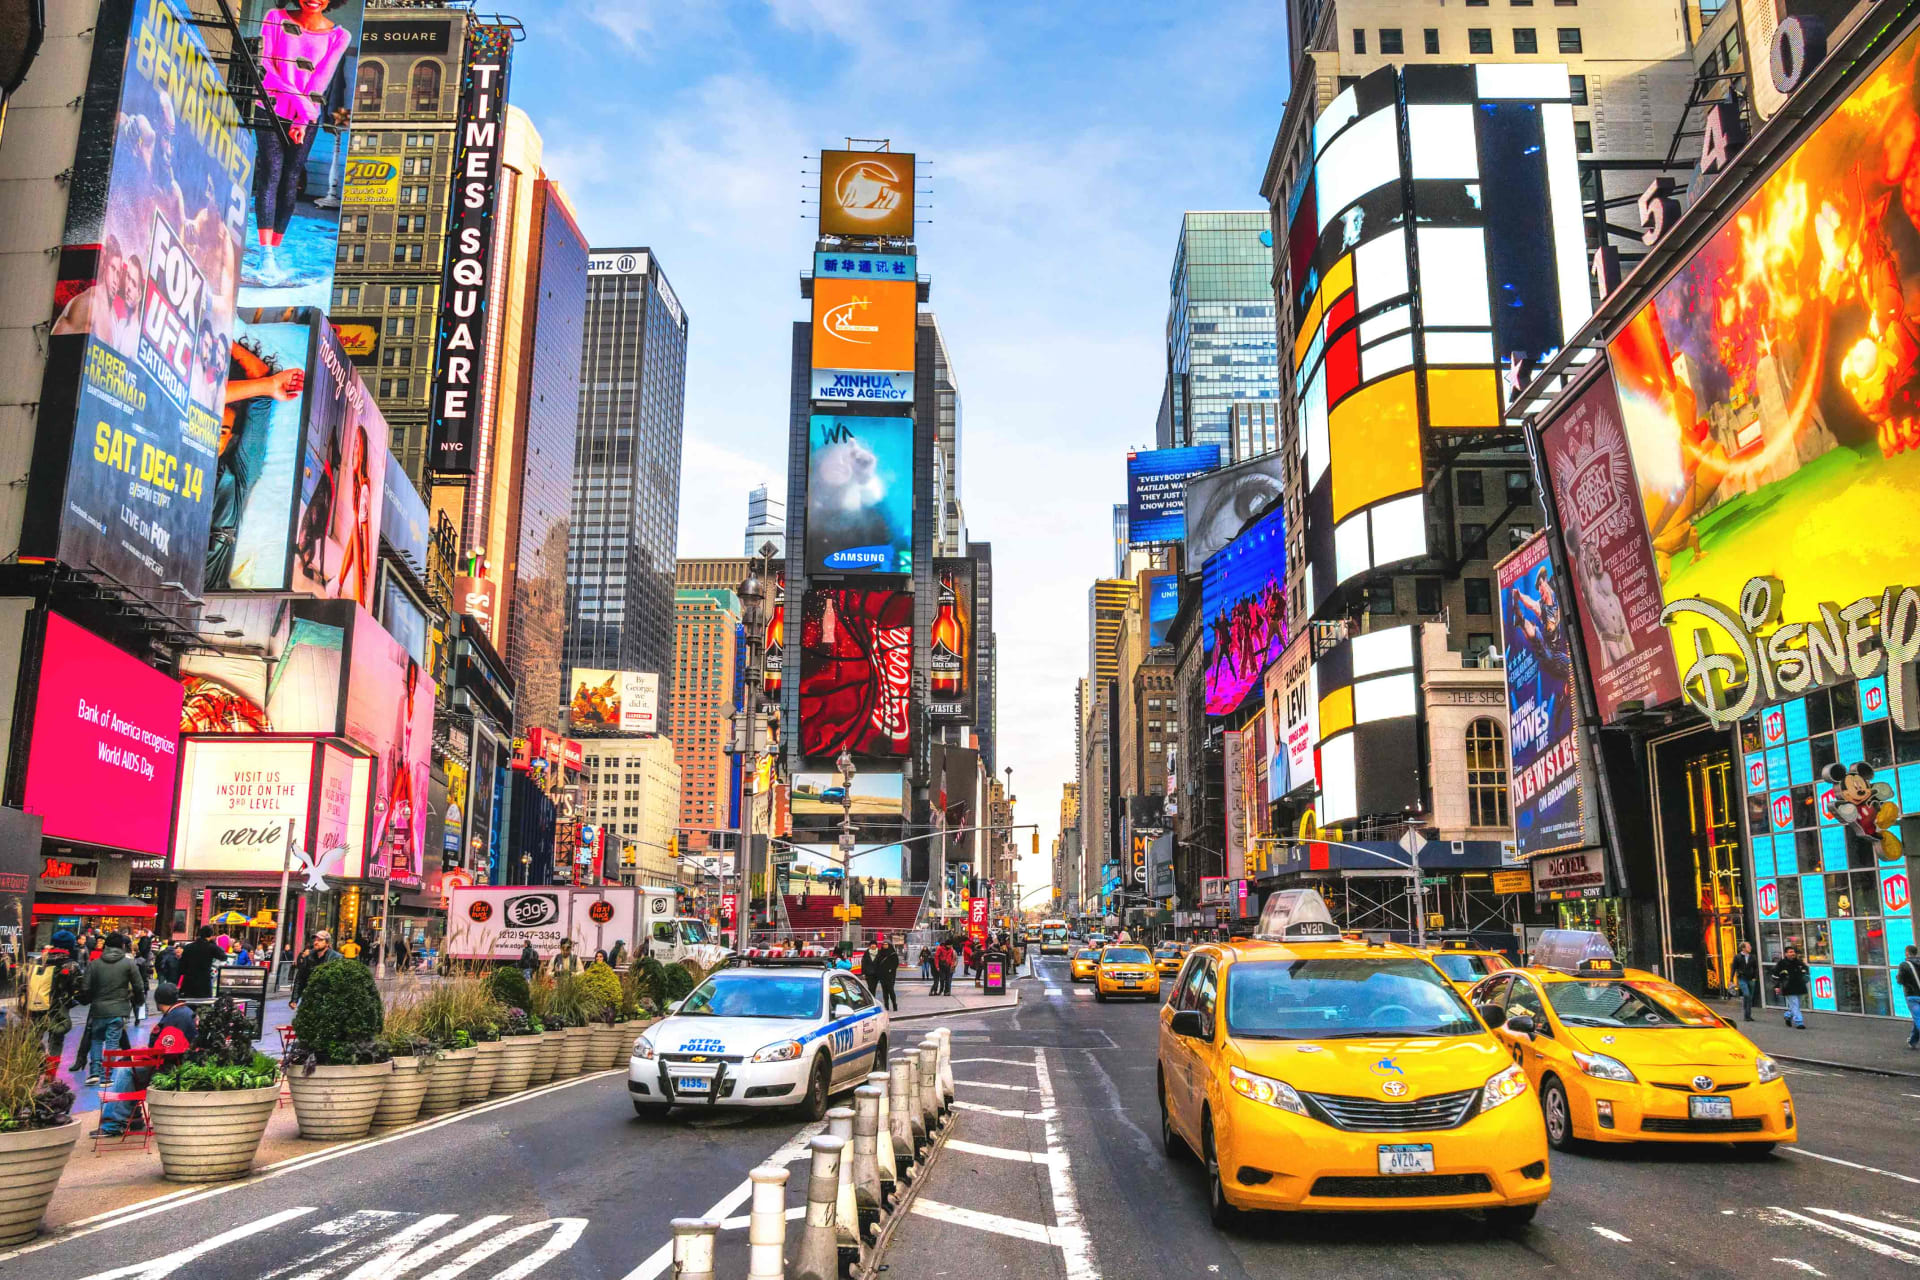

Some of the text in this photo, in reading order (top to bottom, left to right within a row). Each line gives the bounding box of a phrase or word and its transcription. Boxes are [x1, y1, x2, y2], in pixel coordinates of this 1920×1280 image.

[384, 32, 437, 41] SQUARE
[463, 64, 500, 210] TIMES
[226, 182, 247, 249] 2
[150, 215, 200, 332] FOX
[823, 258, 906, 275] 新华通讯社
[442, 228, 485, 419] SQUARE
[145, 292, 193, 378] UFC
[138, 338, 188, 410] SATURDAY
[834, 375, 893, 389] XINHUA
[89, 362, 146, 412] McDONALD
[820, 387, 907, 400] NEWS AGENCY
[440, 442, 464, 451] NYC
[94, 421, 204, 504] SAT. DEC. 14
[1137, 484, 1170, 493] MATILDA
[1141, 492, 1180, 502] THEY JUST
[1140, 502, 1164, 511] KNOW
[120, 504, 171, 558] LIVE ON FOX
[833, 552, 885, 562] SAMSUNG
[1287, 680, 1307, 729] LEVI
[1451, 691, 1476, 703] THE
[78, 698, 176, 755] Bank of America recognizes
[1512, 700, 1549, 755] MOVES
[98, 741, 155, 782] World AIDS Day.
[234, 772, 281, 783] VISIT US
[216, 785, 296, 797] INSIDE ON THE
[249, 799, 280, 810] LEVEL
[1538, 798, 1548, 814] ON
[220, 820, 282, 846] aerie
[1549, 855, 1588, 876] DIGITAL
[1584, 887, 1601, 897] SONY
[515, 902, 549, 921] edge
[973, 900, 985, 923] tkts
[519, 931, 561, 940] 947-3343
[678, 1045, 726, 1053] POLICE
[834, 1027, 854, 1056] NYPD
